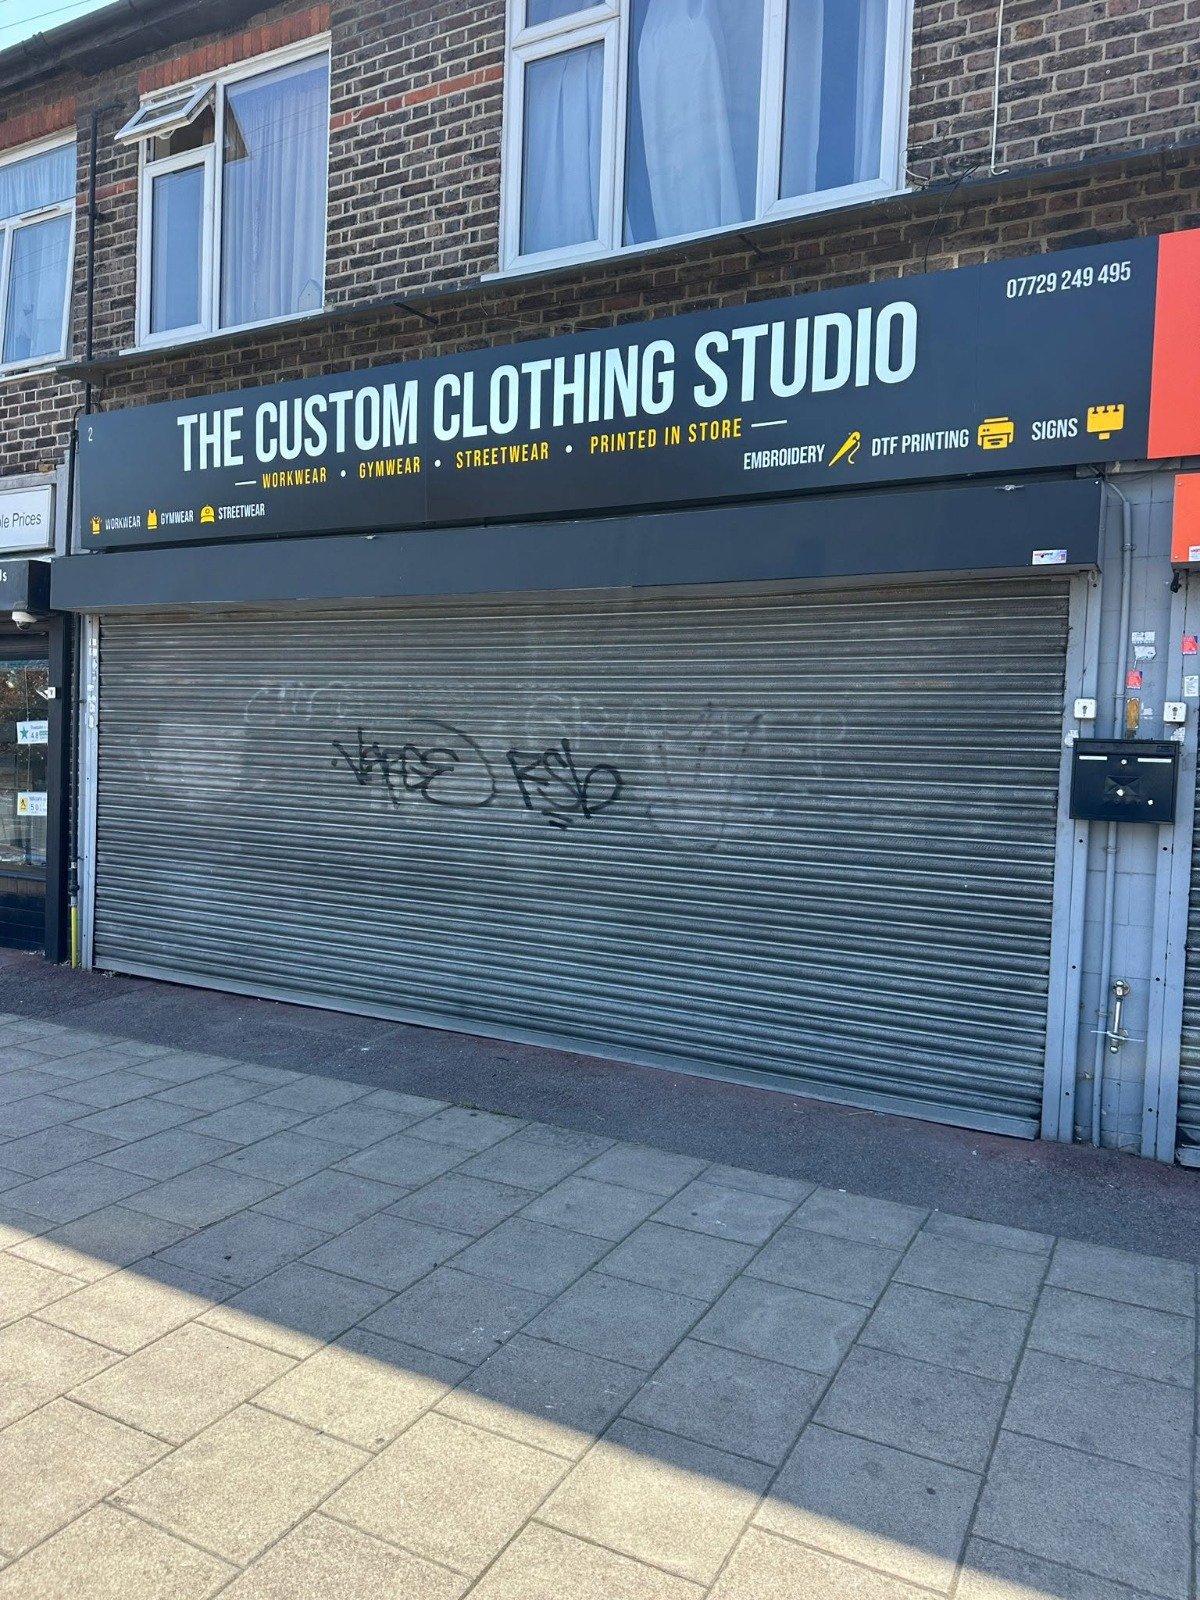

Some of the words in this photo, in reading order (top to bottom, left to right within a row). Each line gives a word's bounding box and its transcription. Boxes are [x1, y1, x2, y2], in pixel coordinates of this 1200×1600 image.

[1006, 272, 1057, 299] 07729
[1060, 266, 1094, 292] 249
[1097, 260, 1132, 284] 495
[176, 406, 244, 472] THE
[255, 379, 419, 463] CUSTOM
[433, 339, 675, 442] CLOTHING
[693, 301, 918, 408] STUDIO
[87, 426, 94, 442] 2
[1031, 417, 1079, 441] SIGNS
[261, 466, 327, 490] WORKWEAR
[358, 457, 421, 481] GYMWEAR
[455, 441, 549, 469] STREETWEAR
[589, 429, 657, 454] PRINTED
[663, 426, 681, 446] IN
[687, 417, 741, 444] STORE
[871, 436, 899, 457] DTF
[901, 428, 970, 455] PRINTING
[742, 443, 825, 471] EMBROIDERY
[12, 512, 42, 527] Prices
[104, 515, 141, 531] WORKWEAR
[160, 509, 194, 526] GYMWEAR
[218, 503, 266, 520] STREETWEAR
